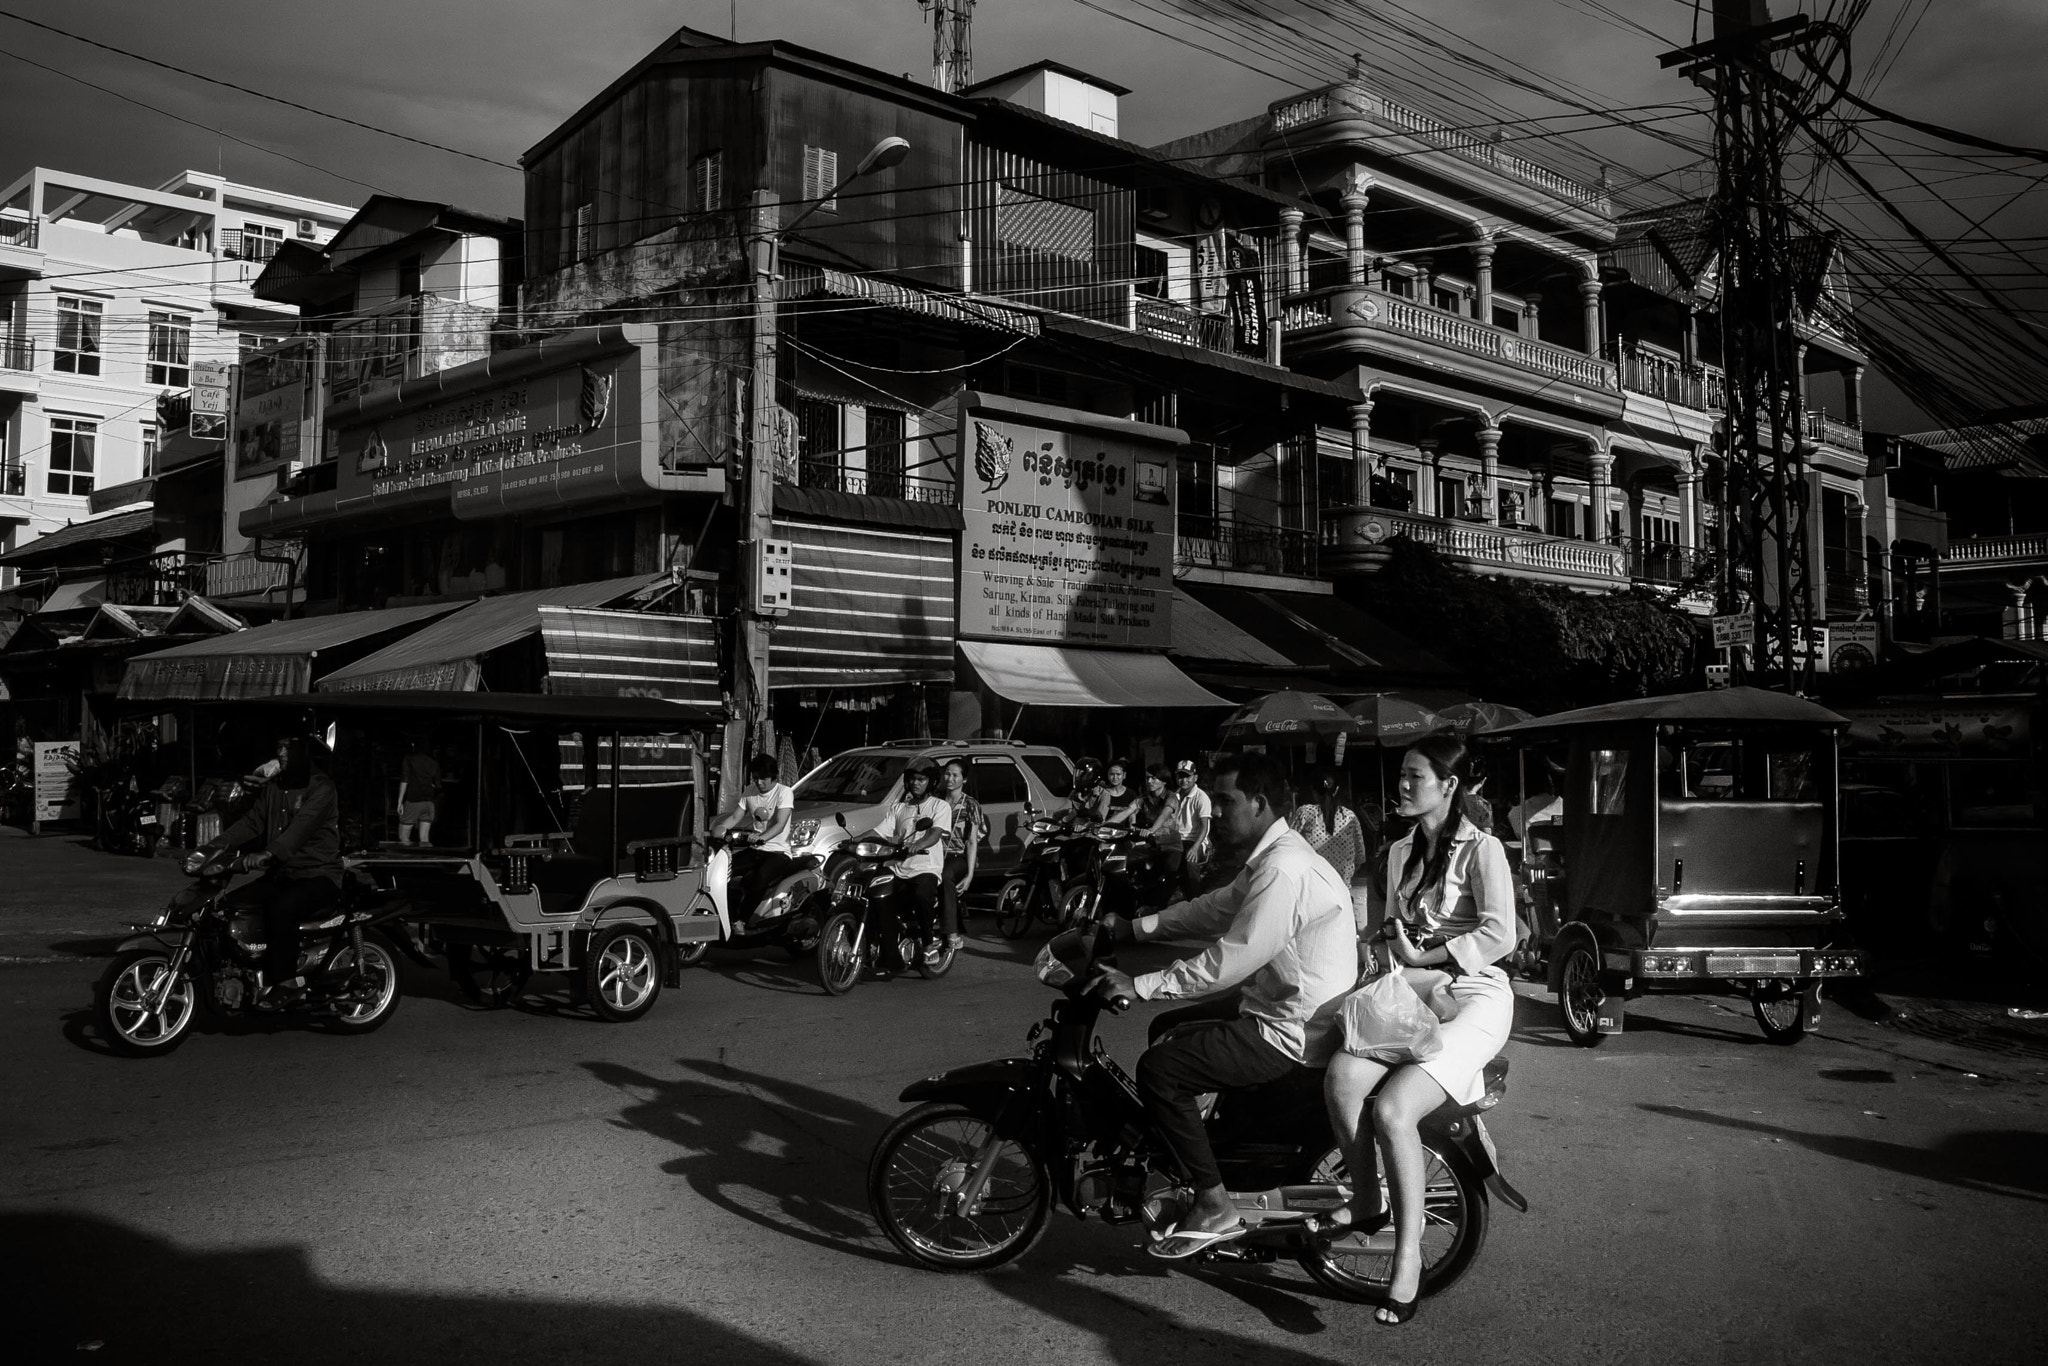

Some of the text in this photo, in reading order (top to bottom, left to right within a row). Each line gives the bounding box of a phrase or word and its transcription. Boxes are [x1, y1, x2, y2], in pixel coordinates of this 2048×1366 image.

[205, 375, 216, 383] Bar
[411, 416, 526, 455] LE PALAIS DE LA SOIE
[537, 443, 582, 464] Products
[987, 500, 1155, 533] PONLEU CAMBODIAN SILK
[1019, 522, 1033, 538] និង
[971, 543, 985, 559] និង
[983, 571, 1024, 588] Weaving
[1026, 575, 1034, 586] &
[1036, 576, 1054, 588] Sale
[1062, 578, 1106, 592] Traditional
[1128, 585, 1155, 597] Pattern
[983, 587, 1018, 604] Sarung,
[1057, 594, 1074, 606] Silk
[1102, 598, 1139, 614] Tailoring
[1140, 602, 1154, 612] and
[989, 604, 1150, 627] all kinds of Hand Made Silk Products
[1742, 629, 1752, 638] 777
